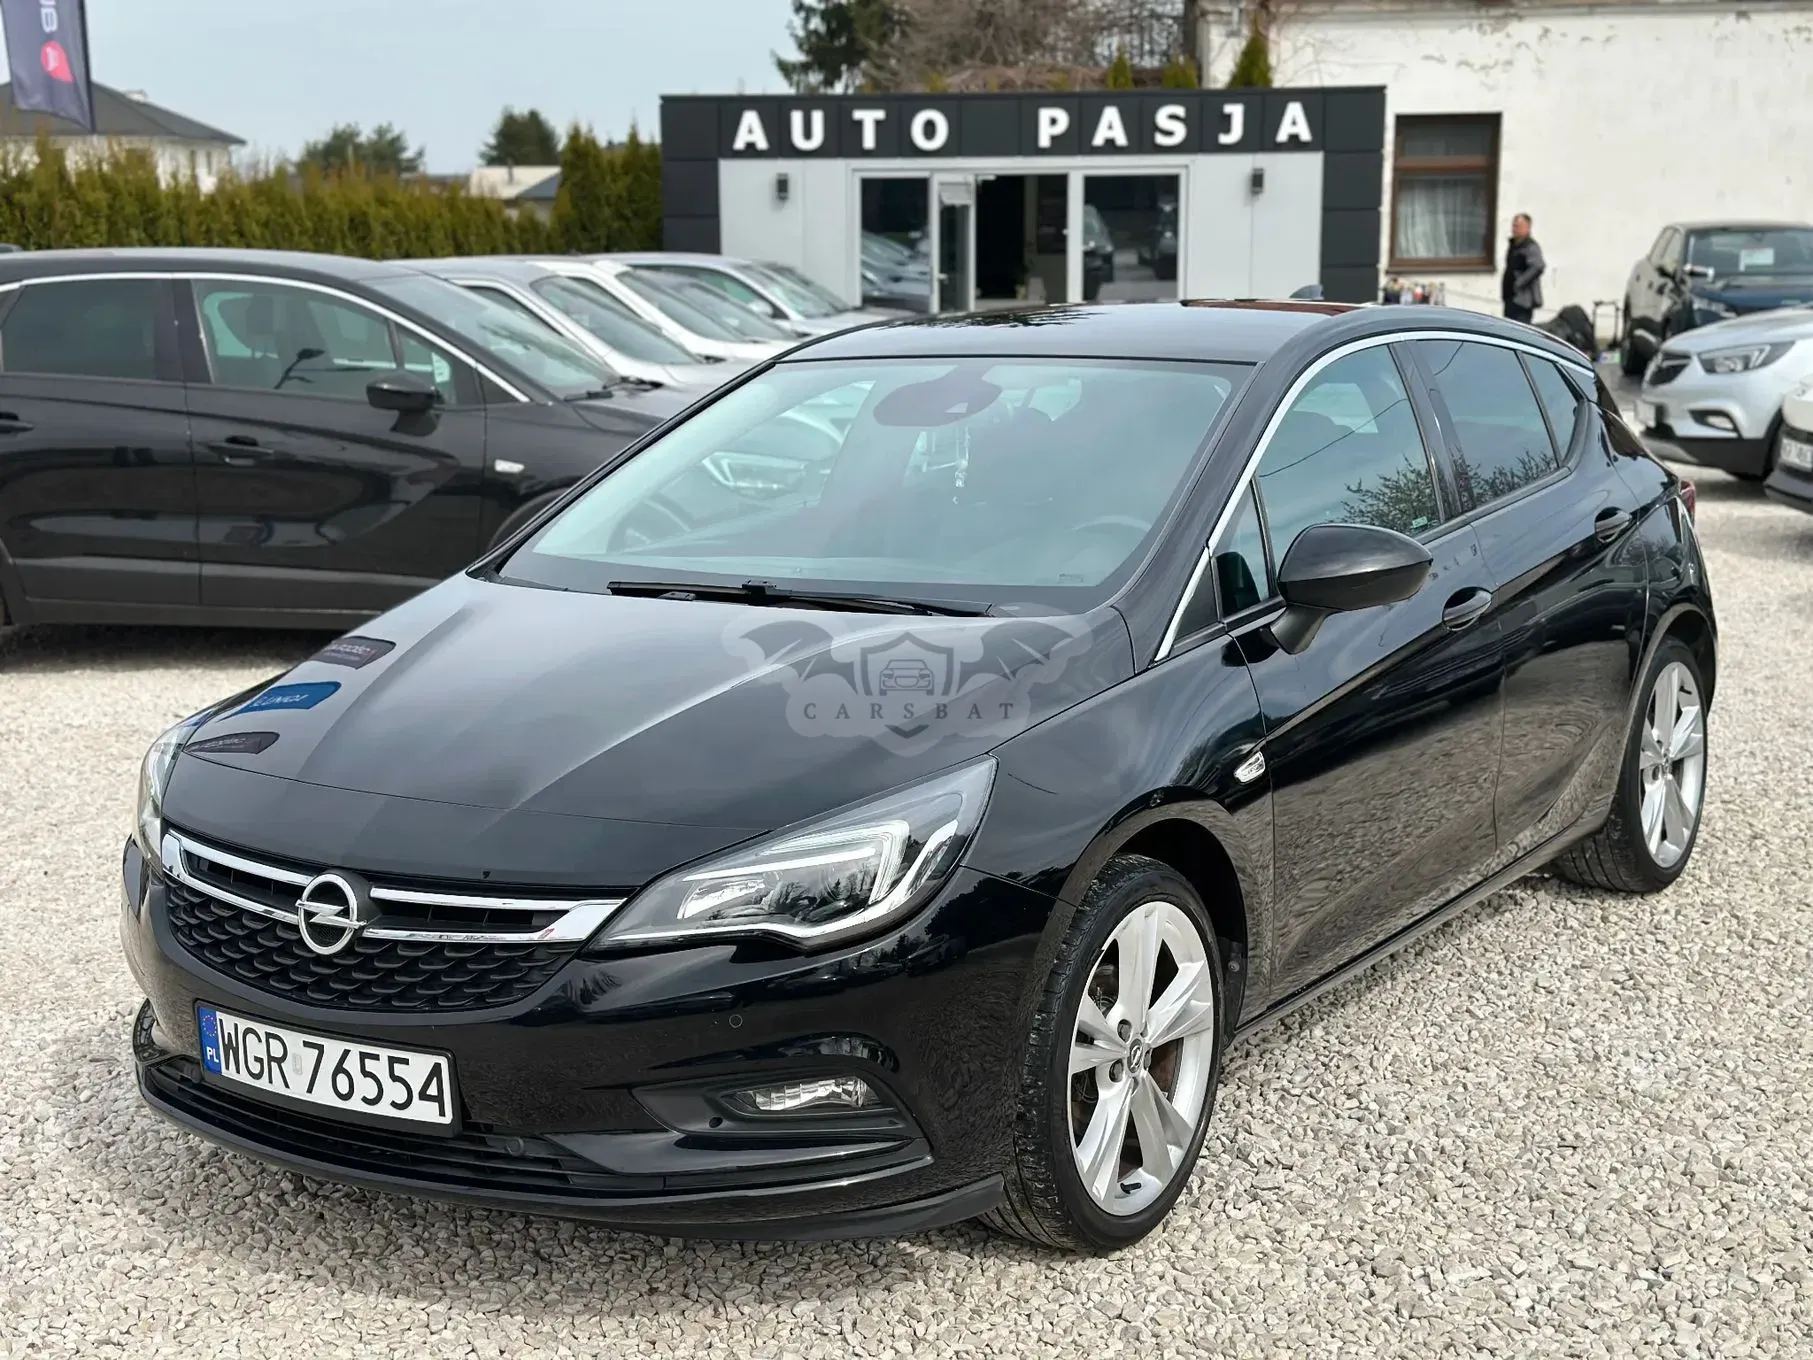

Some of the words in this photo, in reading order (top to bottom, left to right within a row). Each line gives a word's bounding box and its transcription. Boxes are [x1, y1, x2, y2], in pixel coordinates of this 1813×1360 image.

[732, 108, 949, 151] AUTO
[1037, 101, 1312, 148] PASJA
[206, 1046, 220, 1063] PL
[218, 1018, 291, 1090] WGR
[302, 1039, 447, 1118] 76554
